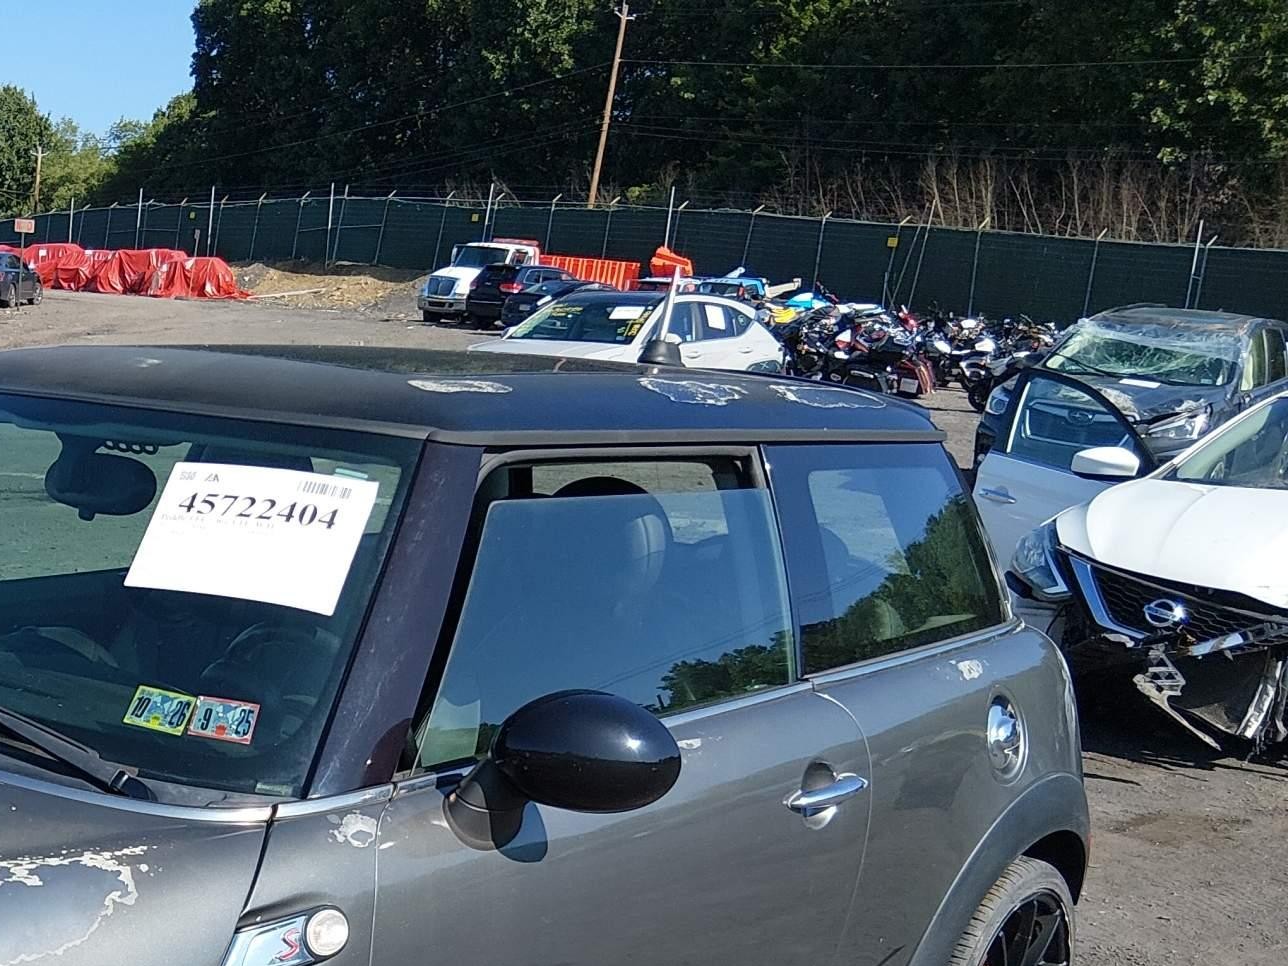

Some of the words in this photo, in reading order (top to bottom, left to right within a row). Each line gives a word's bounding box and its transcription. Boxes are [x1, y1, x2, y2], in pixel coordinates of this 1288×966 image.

[178, 491, 340, 529] 45722404
[131, 695, 151, 719] 10
[168, 700, 192, 728] 26
[234, 708, 255, 737] 25
[275, 927, 301, 961] S
